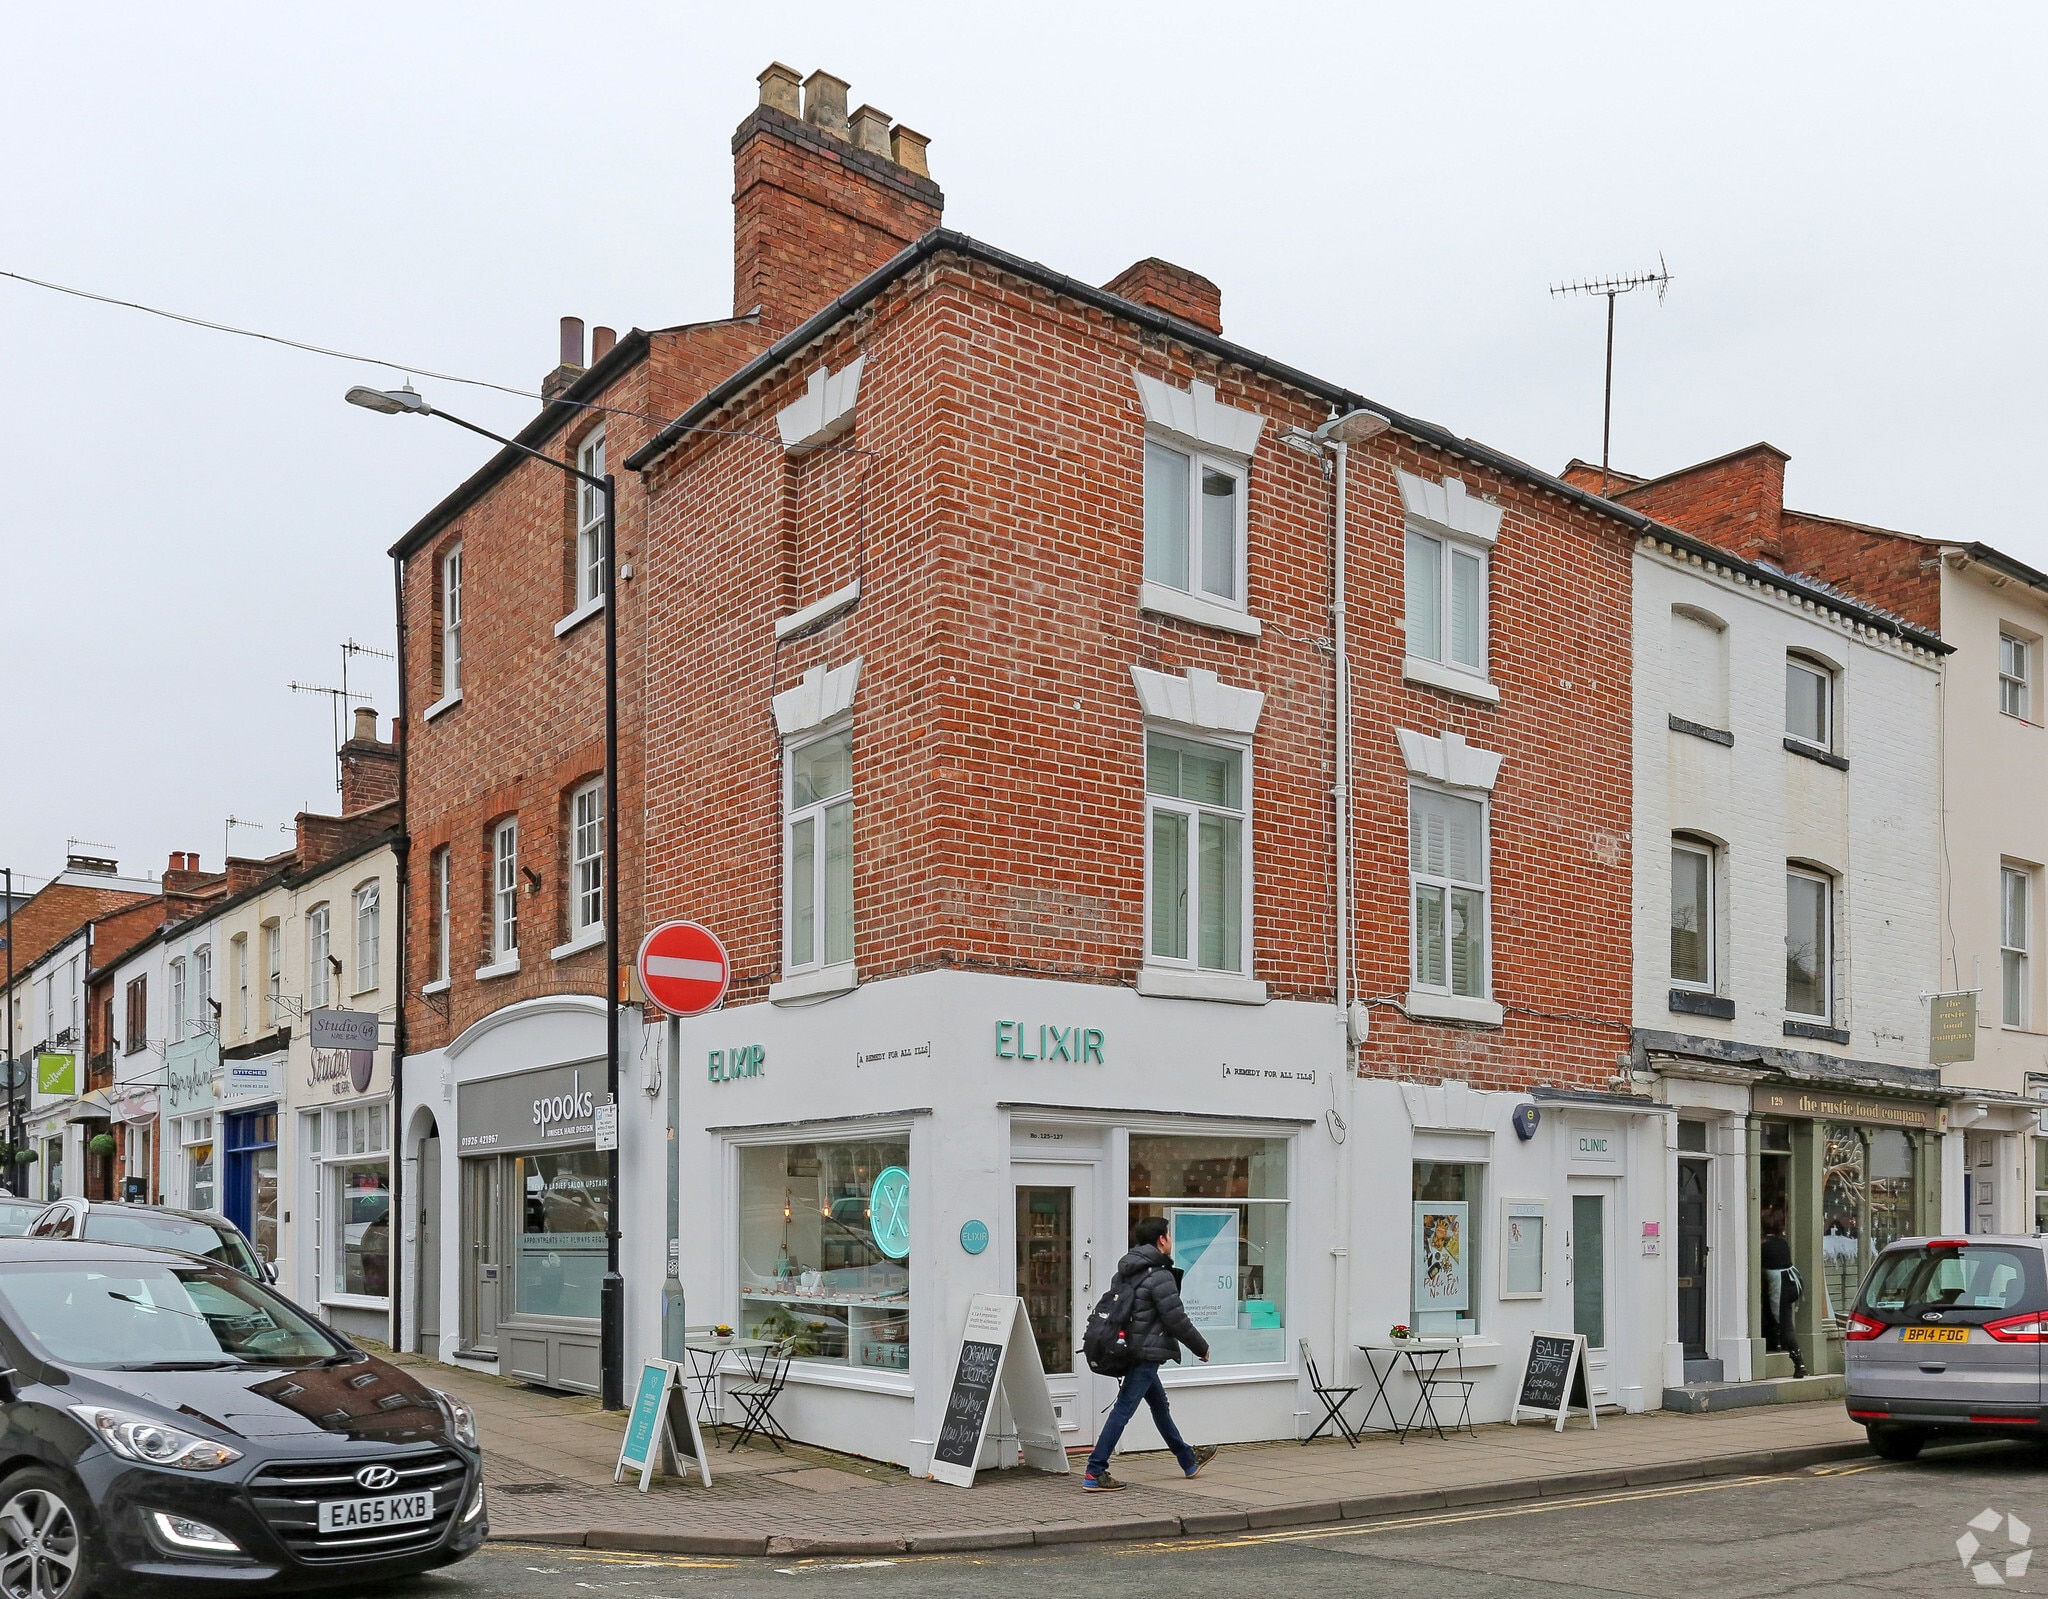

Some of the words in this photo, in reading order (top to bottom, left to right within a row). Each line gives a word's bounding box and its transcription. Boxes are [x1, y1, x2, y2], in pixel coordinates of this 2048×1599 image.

[314, 1018, 358, 1033] Studio
[362, 1024, 374, 1037] 49
[995, 1019, 1106, 1064] ELIXIR
[708, 1043, 766, 1082] ELIXIR
[865, 1052, 886, 1063] REMEDY
[888, 1050, 899, 1060] FOR
[900, 1048, 912, 1058] ALL
[42, 1055, 72, 1091] driftwood
[232, 1069, 267, 1077] STITCHES
[1234, 1068, 1261, 1077] REMEDY
[1264, 1070, 1278, 1079] FOR
[1280, 1071, 1294, 1080] ALL
[532, 1069, 593, 1138] spooks
[1771, 1096, 1784, 1106] 129
[1799, 1095, 1818, 1112] the
[1820, 1100, 1853, 1116] rustic
[1855, 1101, 1879, 1119] food
[1881, 1108, 1926, 1127] company
[547, 1127, 563, 1137] UNISEX
[564, 1125, 576, 1135] HAIR
[576, 1124, 594, 1134] DESIGN
[461, 1136, 478, 1146] 01926
[1579, 1138, 1608, 1153] CLINIC
[567, 1180, 584, 1190] SALON
[585, 1179, 609, 1188] UPSTAIR
[962, 1232, 987, 1241] ELIXIR
[1217, 1275, 1233, 1290] 50
[1423, 1277, 1444, 1289] Pills
[1446, 1273, 1460, 1284] For
[1429, 1287, 1440, 1299] No
[1443, 1283, 1459, 1296] Ills
[1908, 1328, 1935, 1340] BP14
[1938, 1329, 1964, 1341] FDG
[1535, 1339, 1571, 1357] SALE
[1529, 1360, 1553, 1374] 50%
[331, 1500, 386, 1528] EA65
[390, 1496, 426, 1521] KXB
